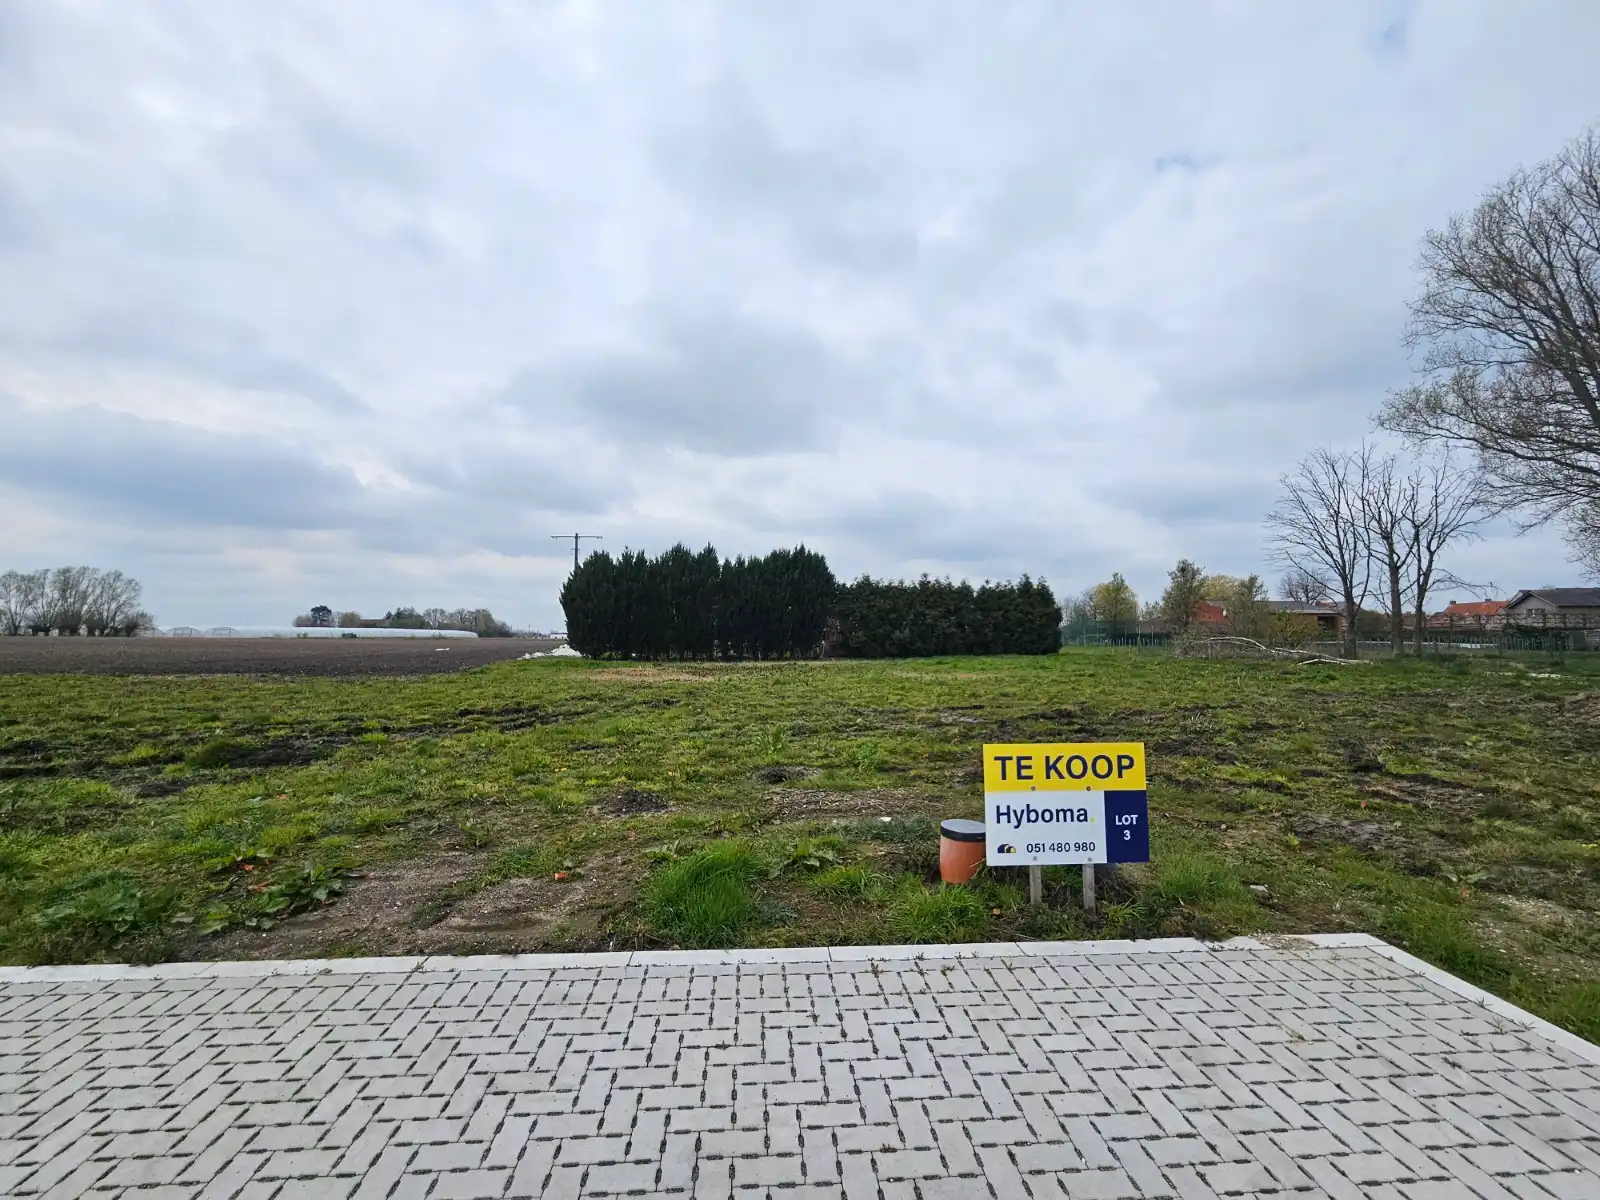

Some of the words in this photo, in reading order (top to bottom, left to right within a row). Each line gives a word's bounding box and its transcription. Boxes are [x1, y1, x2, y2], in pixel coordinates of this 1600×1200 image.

[994, 756, 1034, 780] TE
[1045, 754, 1135, 780] KOOP
[1115, 814, 1138, 825] LOT
[1123, 830, 1131, 840] 3
[1026, 843, 1045, 853] 051
[1049, 842, 1071, 852] 480
[1074, 841, 1096, 852] 980
